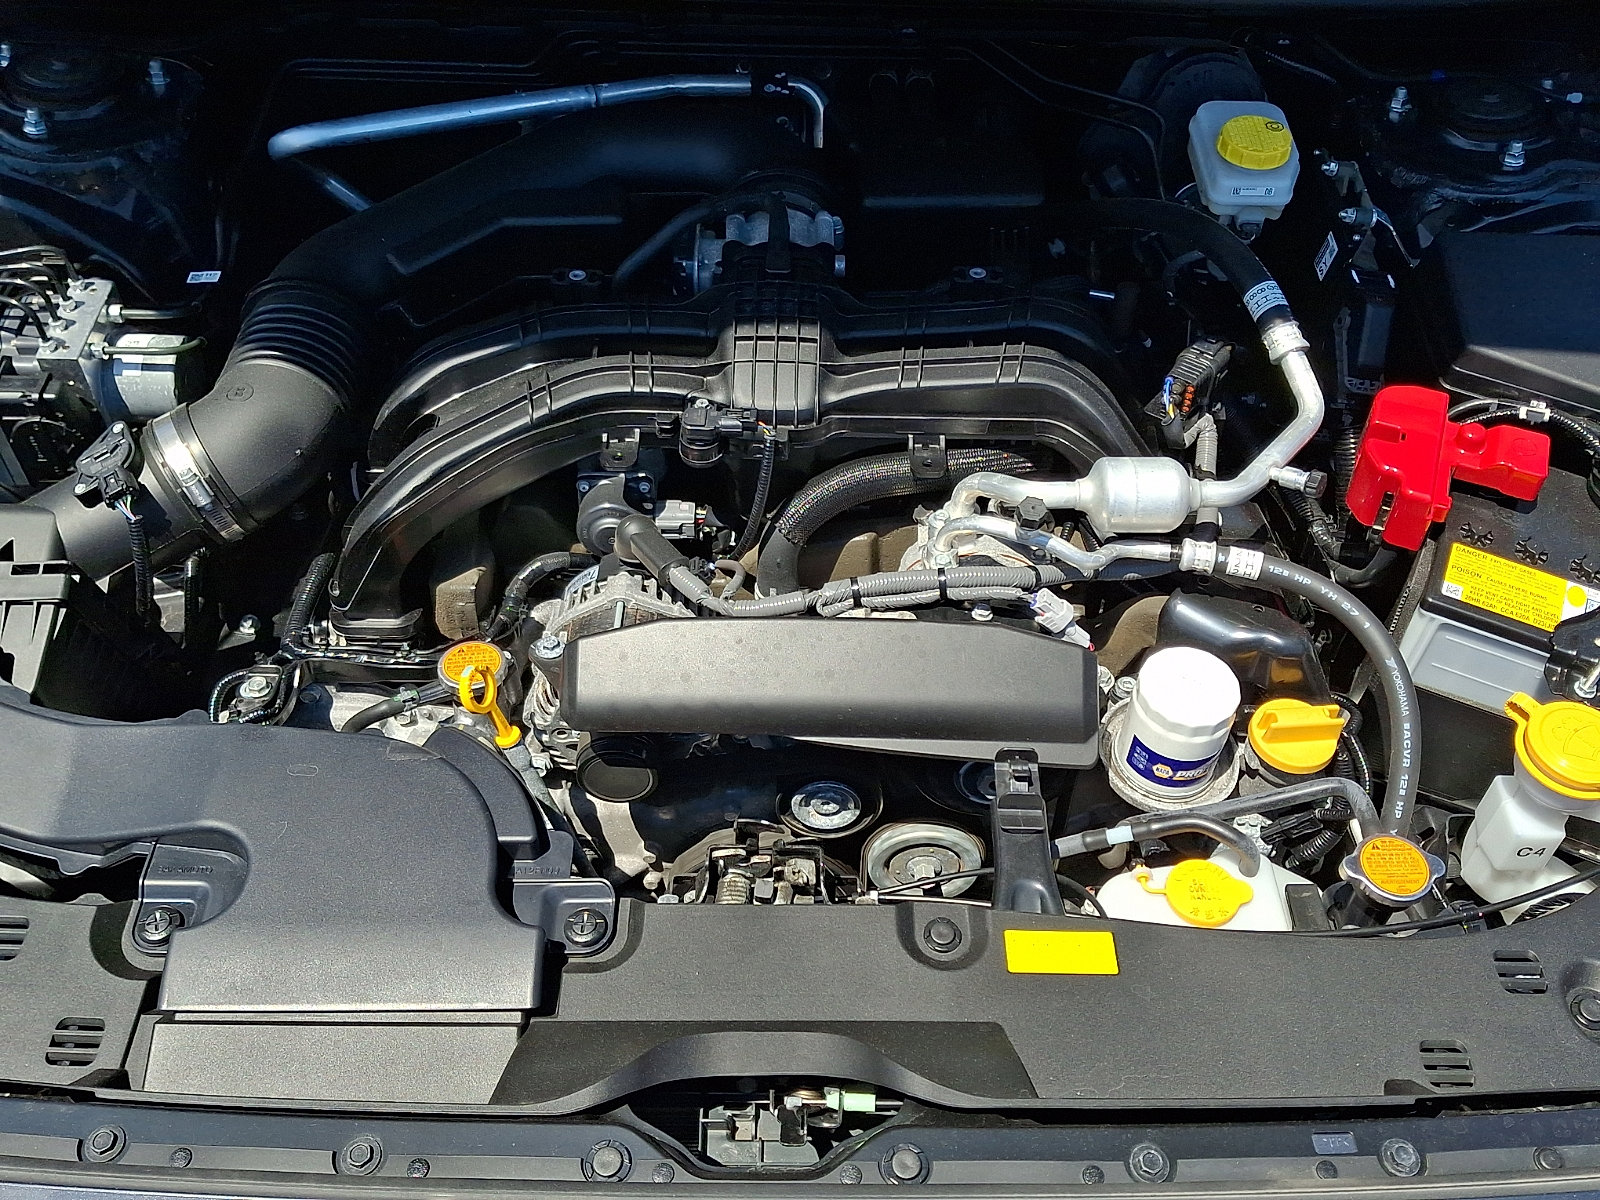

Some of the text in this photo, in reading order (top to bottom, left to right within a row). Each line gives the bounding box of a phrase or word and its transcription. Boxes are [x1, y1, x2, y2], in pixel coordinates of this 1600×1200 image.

[1456, 546, 1537, 577] DANGER EXPLOSIVE GASES
[1294, 574, 1312, 586] HP
[1320, 585, 1338, 601] YH
[1341, 601, 1360, 616] 27
[1452, 565, 1548, 602] POISON CAUSES SEVERE BURNS
[1469, 590, 1484, 598] KEEP
[1504, 601, 1523, 611] REACH
[1531, 611, 1559, 623] CHILDREN
[1470, 585, 1485, 593] KEEP
[1485, 591, 1500, 599] VENT
[1499, 595, 1514, 603] CAPS
[1515, 600, 1531, 609] TIGHT
[1543, 610, 1559, 619] LEVEL
[1500, 606, 1514, 616] CCA
[1391, 669, 1410, 717] YOKOHAMA
[1395, 801, 1404, 819] HP
[1516, 847, 1547, 857] C4
